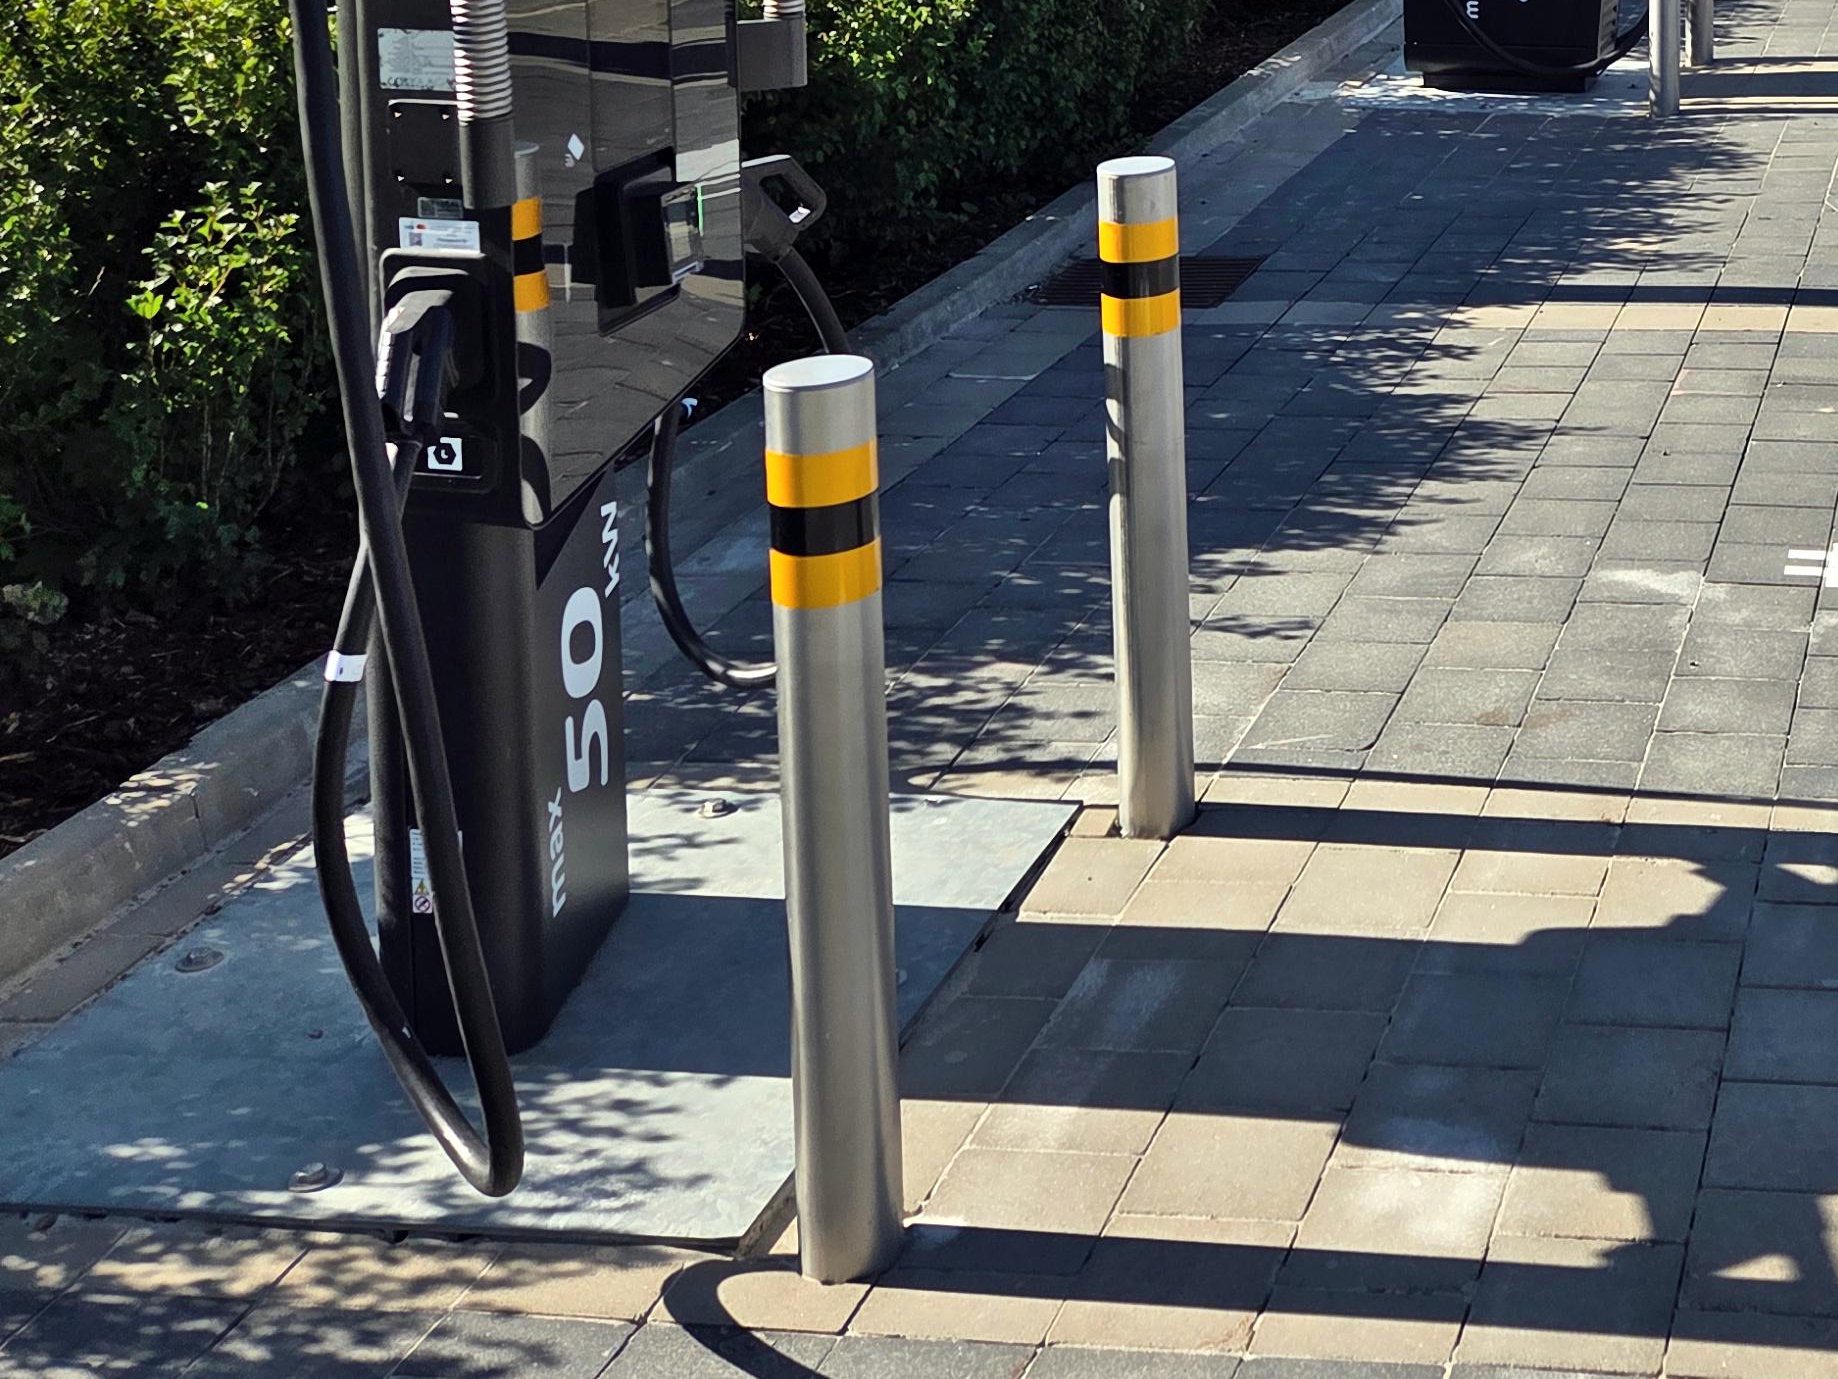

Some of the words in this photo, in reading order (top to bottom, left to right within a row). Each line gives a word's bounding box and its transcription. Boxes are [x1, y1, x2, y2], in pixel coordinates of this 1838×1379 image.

[600, 501, 620, 598] kW
[561, 586, 608, 793] 50
[548, 787, 567, 918] max
